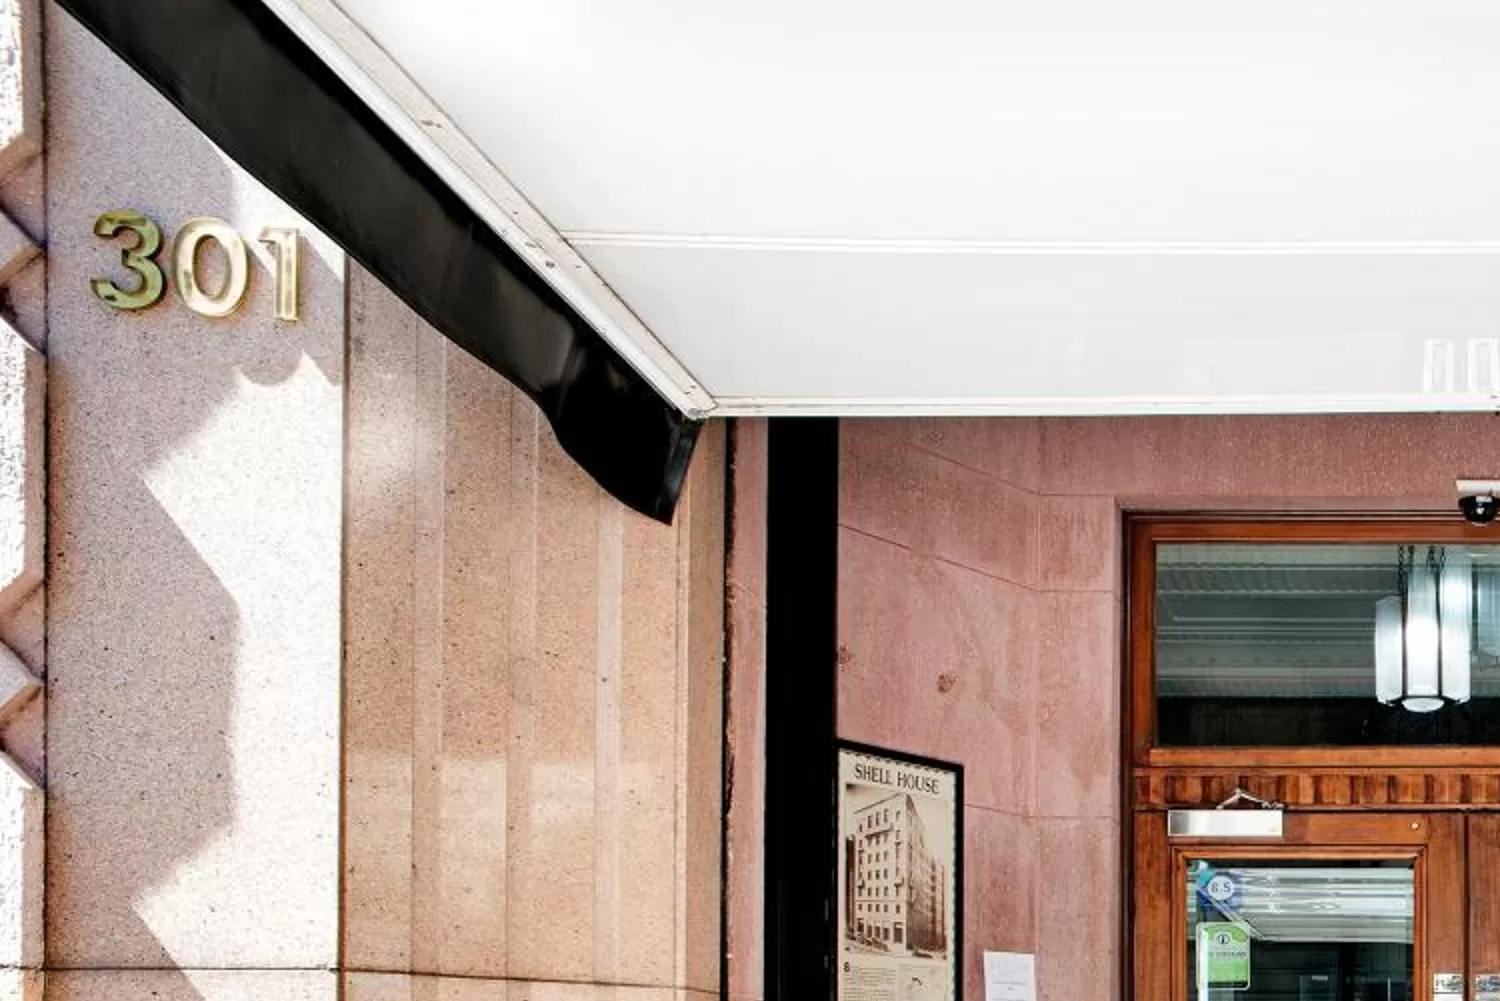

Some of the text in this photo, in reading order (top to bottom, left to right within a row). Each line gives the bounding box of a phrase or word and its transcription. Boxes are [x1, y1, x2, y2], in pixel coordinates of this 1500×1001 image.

[89, 208, 301, 322] 301
[854, 763, 940, 795] SHELL HOUSE
